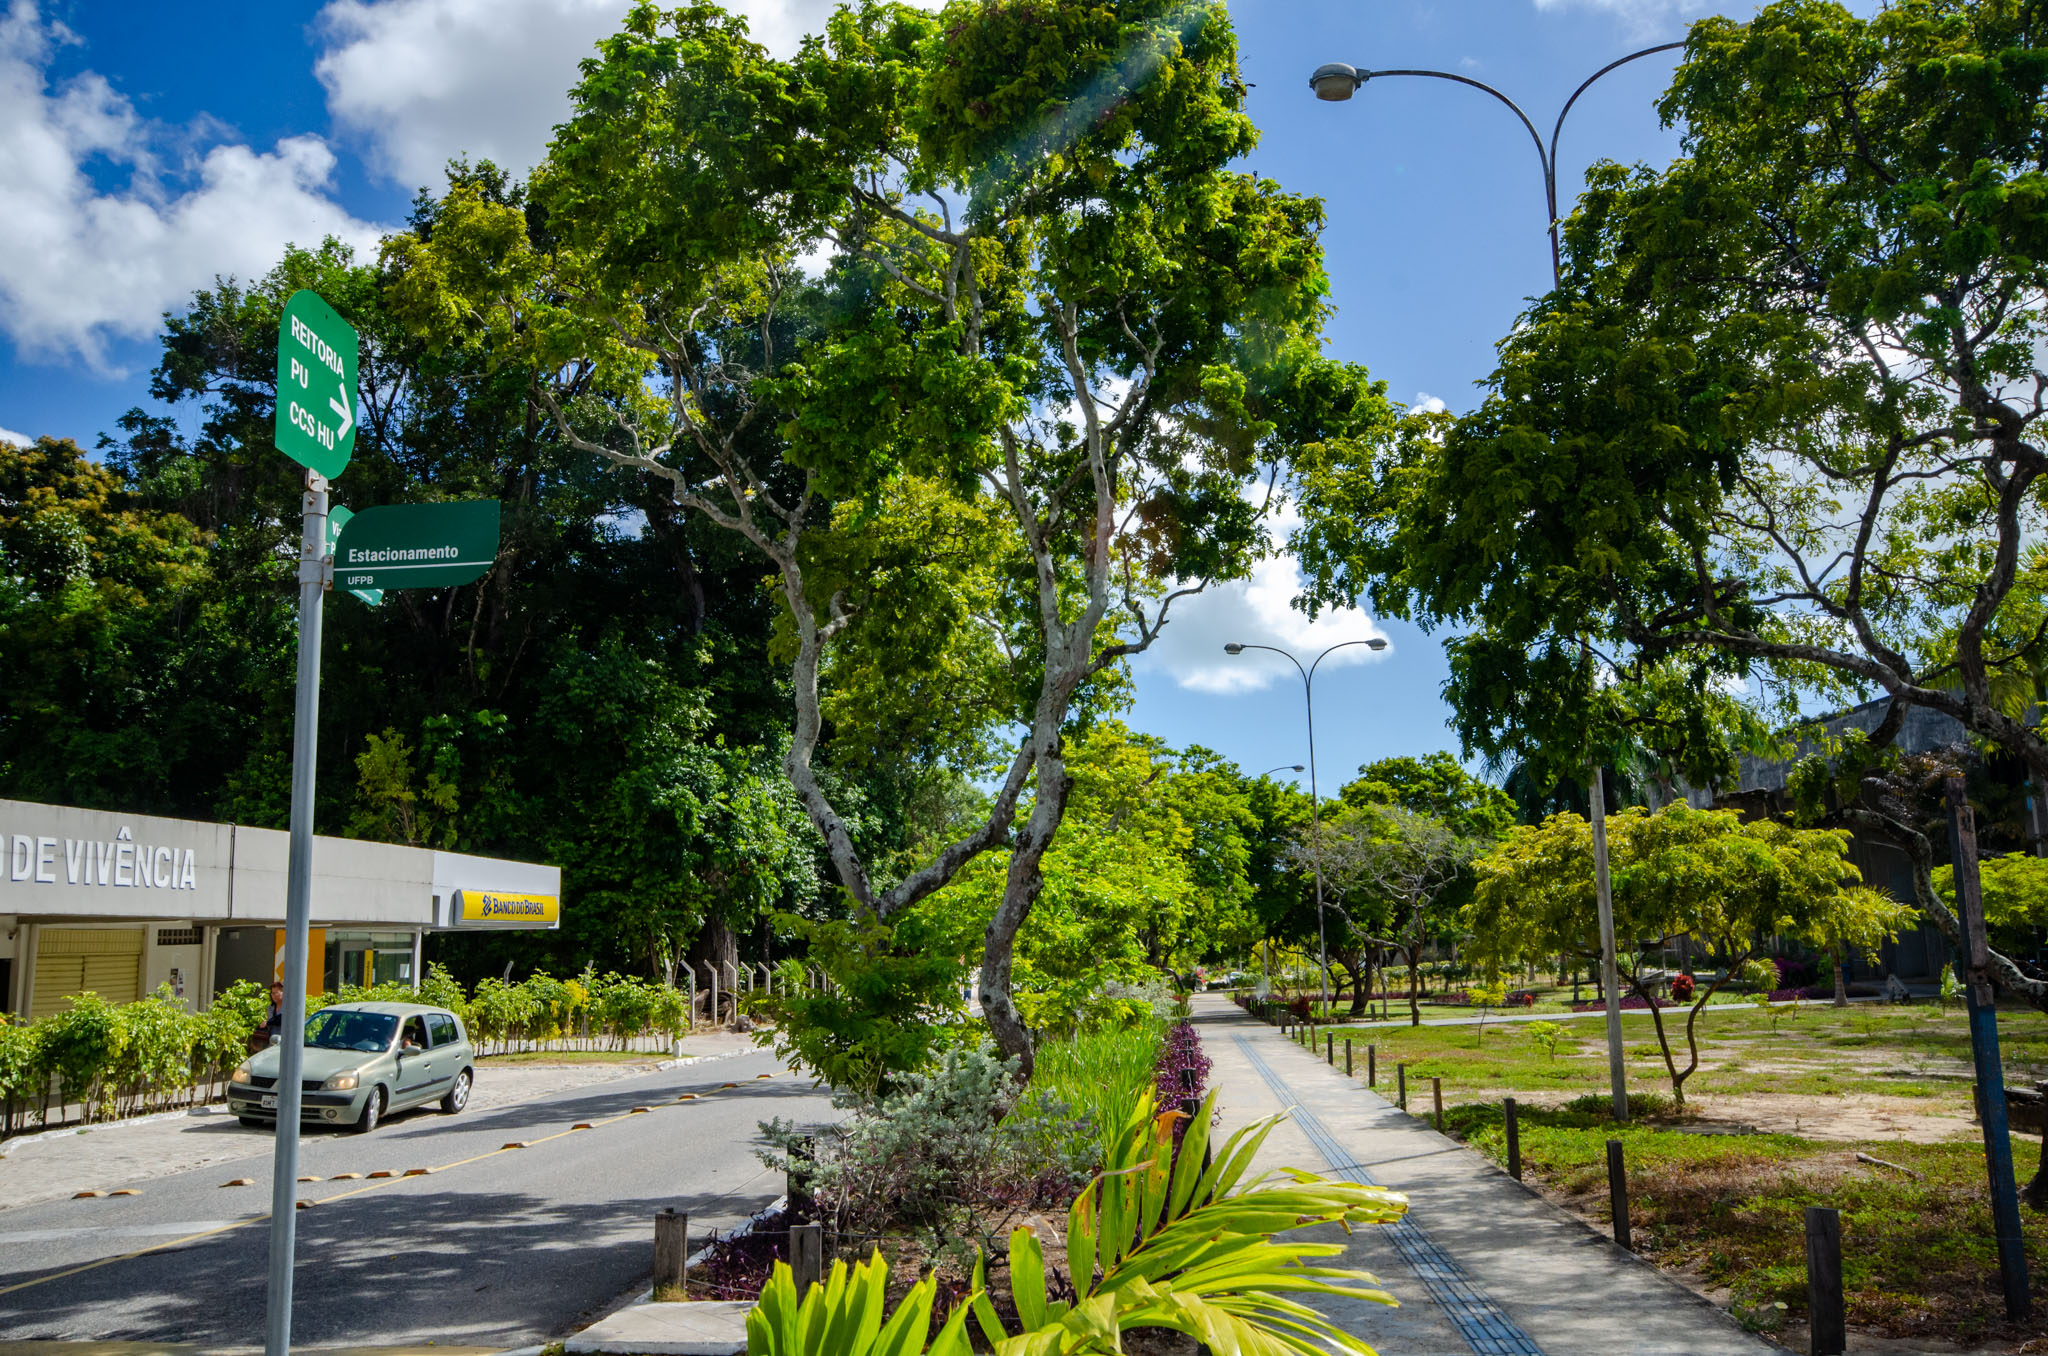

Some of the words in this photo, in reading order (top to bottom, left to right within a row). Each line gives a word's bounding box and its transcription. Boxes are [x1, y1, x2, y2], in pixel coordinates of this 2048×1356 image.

[291, 314, 345, 380] REITORIA
[291, 357, 308, 389] PU
[290, 401, 315, 437] CCS
[317, 420, 334, 451] HU
[348, 545, 459, 563] Estacionamento
[347, 575, 374, 585] UFPB
[11, 834, 57, 883] DE
[64, 825, 196, 890] VIVÊNCIA
[493, 898, 515, 915] BANCO
[524, 899, 544, 915] BRASIL
